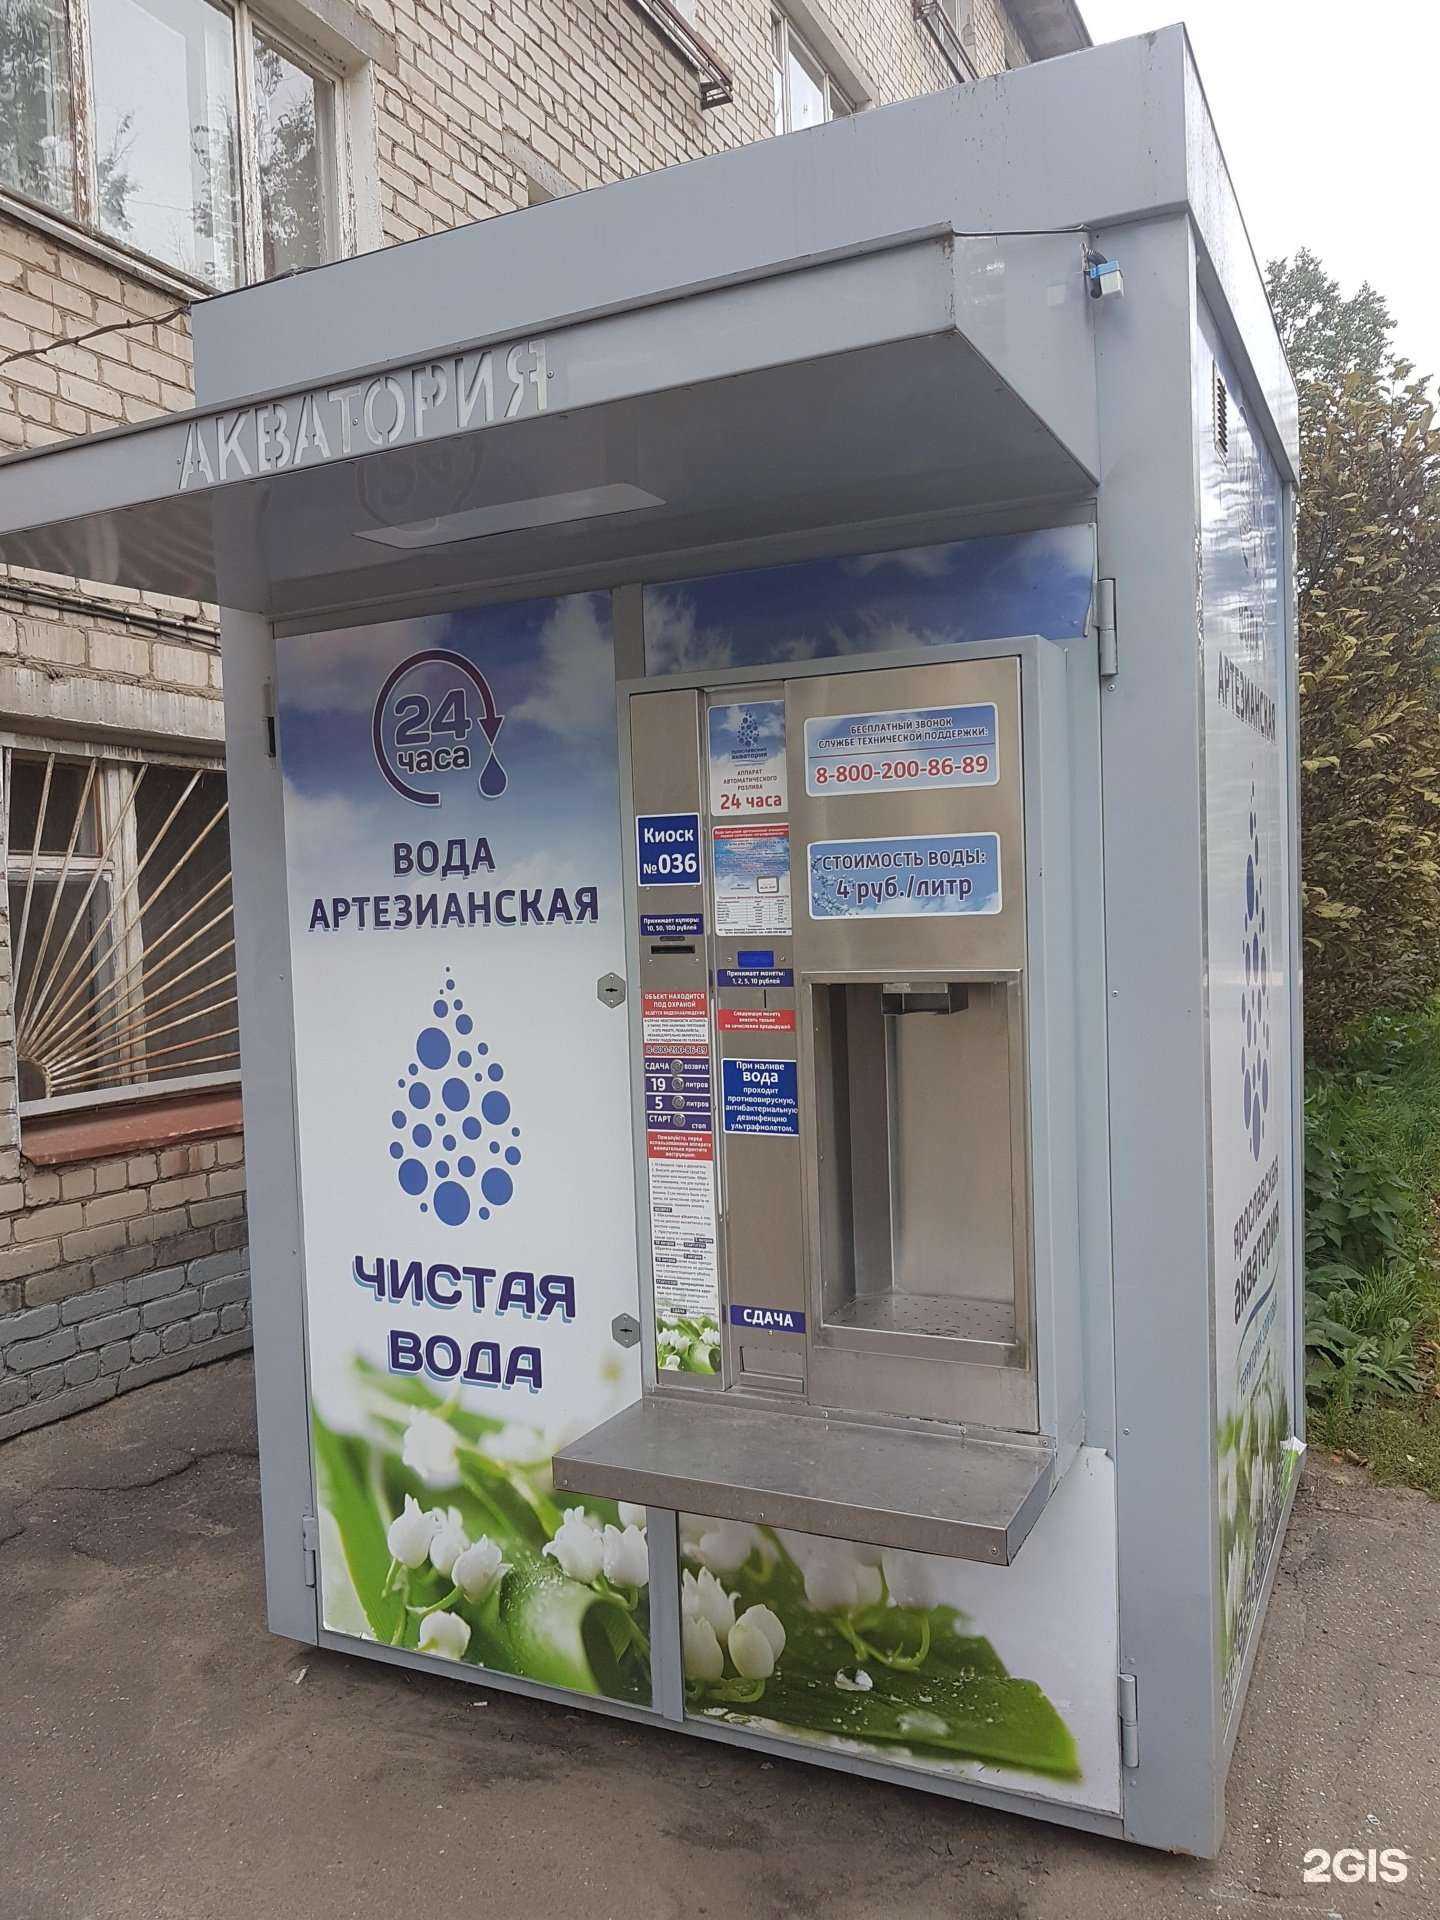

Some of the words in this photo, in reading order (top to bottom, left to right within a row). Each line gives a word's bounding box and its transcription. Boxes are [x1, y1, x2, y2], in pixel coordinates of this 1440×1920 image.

[177, 340, 548, 490] АКВАТОРИЯ
[1218, 650, 1277, 741] АРТЕЗИАНСКАЯ
[395, 687, 472, 746] 24
[851, 721, 912, 735] БЕСПЛАТНЫЙ
[915, 717, 952, 729] ЗВОНОК
[818, 737, 856, 749] СЛУЖБЕ
[857, 731, 922, 747] ТЕХНИЧЕСКОЙ
[924, 727, 988, 741] ПОДДЕРЖКИ:
[397, 746, 471, 773] часа
[815, 755, 989, 784] 8-800-200-86-89
[723, 776, 778, 785] АВТОМАТИЧЕСКОГО
[720, 794, 741, 810] 24
[746, 794, 782, 808] часа
[644, 826, 694, 843] Киоск
[393, 837, 496, 879] ВОДА
[822, 851, 923, 871] СТОИМОСТЬ
[928, 848, 986, 867] ВОДЫ:
[836, 878, 850, 899] 4
[308, 885, 600, 931] АРТЕЗИАНСКАЯ
[643, 917, 674, 925] Принимает
[676, 923, 697, 932] рублей
[726, 970, 759, 978] Принимает
[758, 977, 781, 986] рублей
[667, 1000, 696, 1008] ОХРАНОЙ
[645, 1062, 669, 1070] СДАЧА
[736, 1061, 753, 1070] При
[754, 1062, 785, 1071] наливе
[651, 1078, 666, 1091] 19
[743, 1071, 779, 1086] вода
[743, 1086, 779, 1095] проходит
[655, 1096, 663, 1109] 5
[727, 1095, 796, 1106] противовирусную,
[725, 1104, 799, 1115] антибактериальную
[649, 1115, 672, 1123] СТАРТ
[1234, 1199, 1280, 1325] акватория
[353, 1254, 576, 1323] ЧИСТАЯ
[743, 1308, 794, 1327] СДАЧА
[388, 1329, 543, 1393] ВОДА
